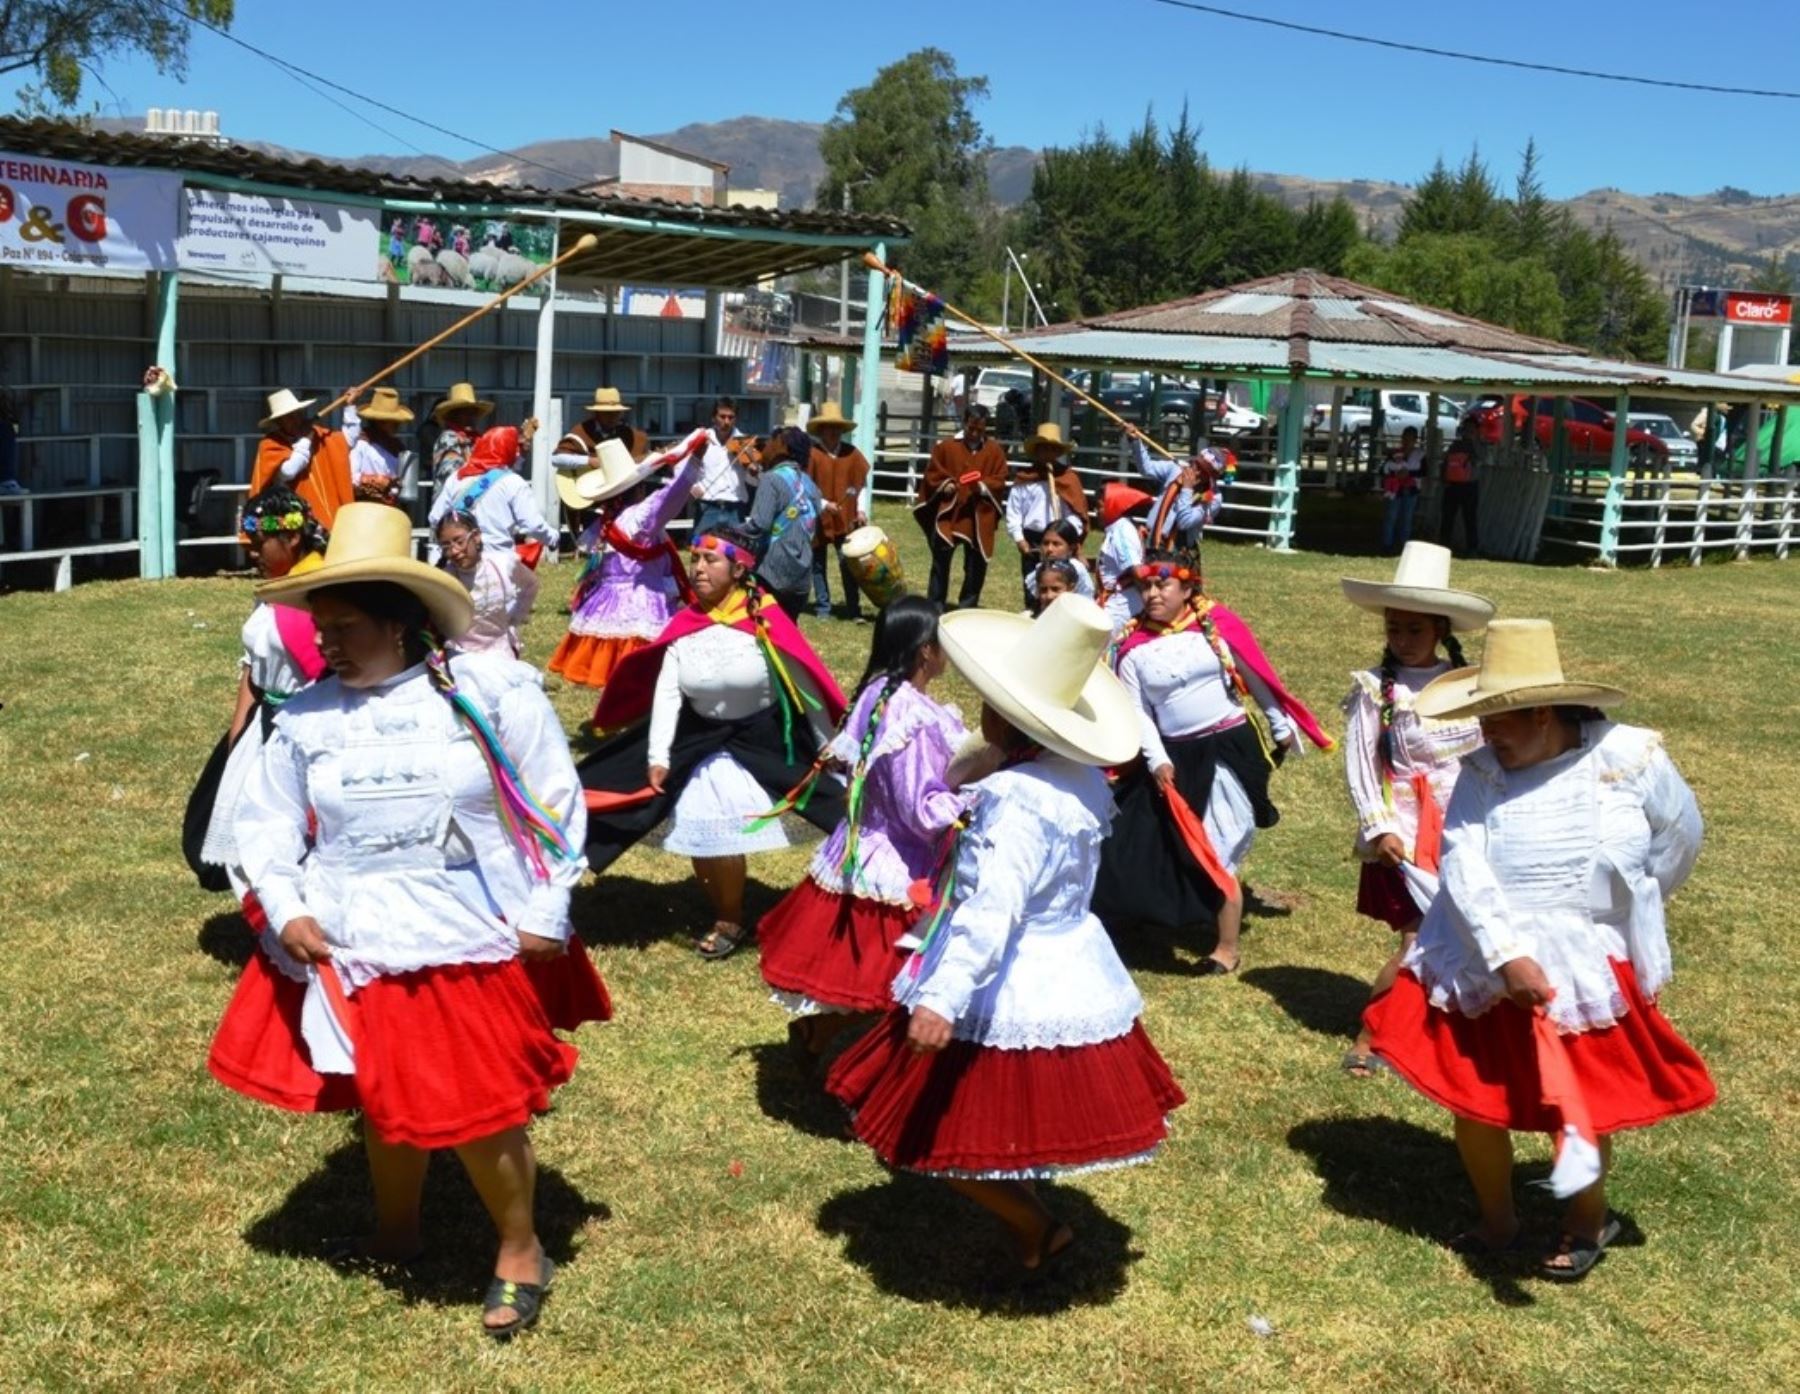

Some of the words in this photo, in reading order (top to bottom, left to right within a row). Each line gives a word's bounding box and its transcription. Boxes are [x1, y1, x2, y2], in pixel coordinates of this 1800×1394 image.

[19, 205, 65, 243] &
[67, 193, 107, 243] G
[248, 217, 299, 231] desarrollo
[301, 223, 313, 233] de
[187, 226, 250, 240] productores
[252, 232, 326, 248] cajamarquinos
[1736, 301, 1773, 318] Claro
